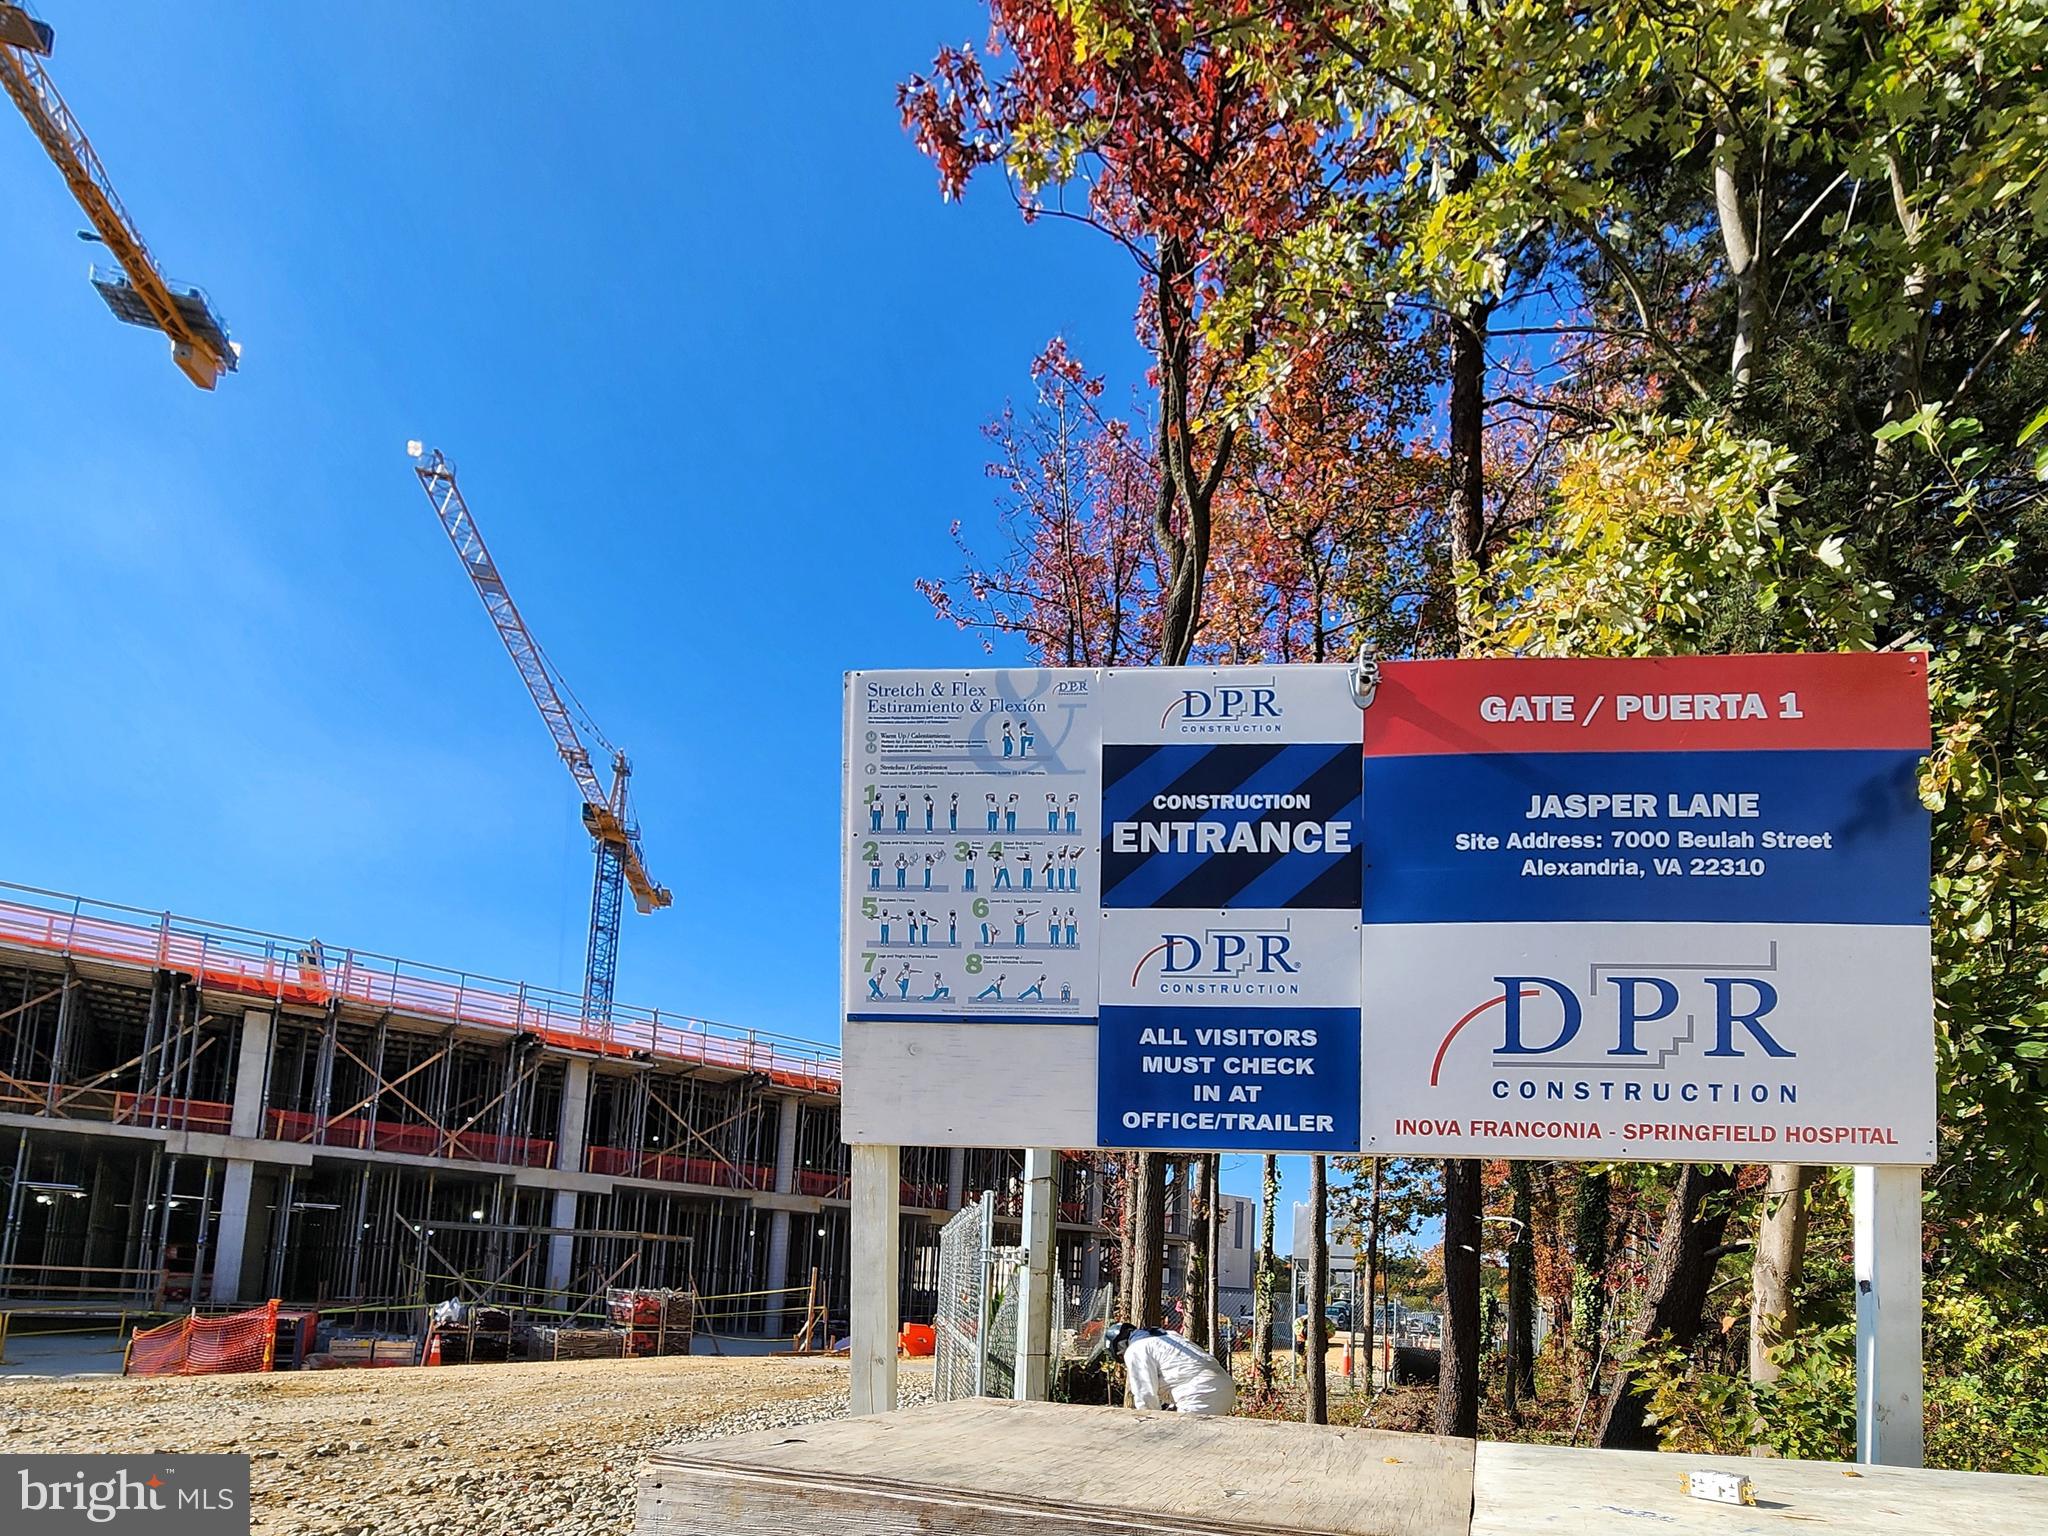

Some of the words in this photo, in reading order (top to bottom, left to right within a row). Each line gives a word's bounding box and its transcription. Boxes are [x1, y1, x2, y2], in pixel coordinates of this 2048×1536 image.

[867, 682, 925, 697] Stretch
[931, 682, 945, 697] &
[951, 682, 987, 697] Flex
[867, 699, 965, 713] Estiramiento
[970, 699, 983, 713] &
[989, 698, 1046, 713] Flexión
[1182, 689, 1281, 718] DPR
[1480, 696, 1575, 722] GATE
[1581, 696, 1605, 727] /
[1616, 693, 1768, 721] PUERTA
[1779, 692, 1804, 719] 1
[1181, 724, 1282, 733] CONSTRUCTION
[864, 784, 876, 805] 1
[1152, 794, 1311, 811] CONSTRUCTION
[1525, 794, 1658, 819] JASPER
[1668, 793, 1760, 818] LANE
[1112, 821, 1352, 854] ENTRANCE
[1455, 833, 1500, 851] Site
[1506, 832, 1603, 849] Address:
[1611, 831, 1671, 849] 7000
[1678, 831, 1755, 849] Beulah
[1761, 831, 1833, 849] Street
[862, 841, 878, 861] 2
[954, 841, 970, 862] 3
[988, 841, 1004, 860] 4
[1521, 858, 1646, 879] Alexandria,
[1653, 858, 1683, 876] VA
[1690, 858, 1766, 876] 22310
[861, 896, 878, 917] 5
[972, 897, 990, 919] 6
[861, 952, 877, 973] 7
[965, 953, 983, 975] 8
[1160, 934, 1299, 973] DPR
[1160, 983, 1300, 995] CONSTRUCTION
[1492, 976, 1797, 1058] DPR
[1139, 1028, 1188, 1045] ALL
[1195, 1029, 1318, 1047] VISITORS
[1142, 1056, 1216, 1074] MUST
[1223, 1057, 1315, 1075] CHECK
[1193, 1085, 1221, 1102] IN
[1228, 1085, 1262, 1102] AT
[1492, 1080, 1798, 1103] CONSTRUCTION
[1122, 1111, 1335, 1132] OFFICE/TRAILER
[1395, 1119, 1462, 1137] INOVA
[1470, 1120, 1602, 1140] FRANCONIA
[1623, 1123, 1777, 1143] SPRINGFIELD
[1785, 1125, 1899, 1145] HOSPITAL
